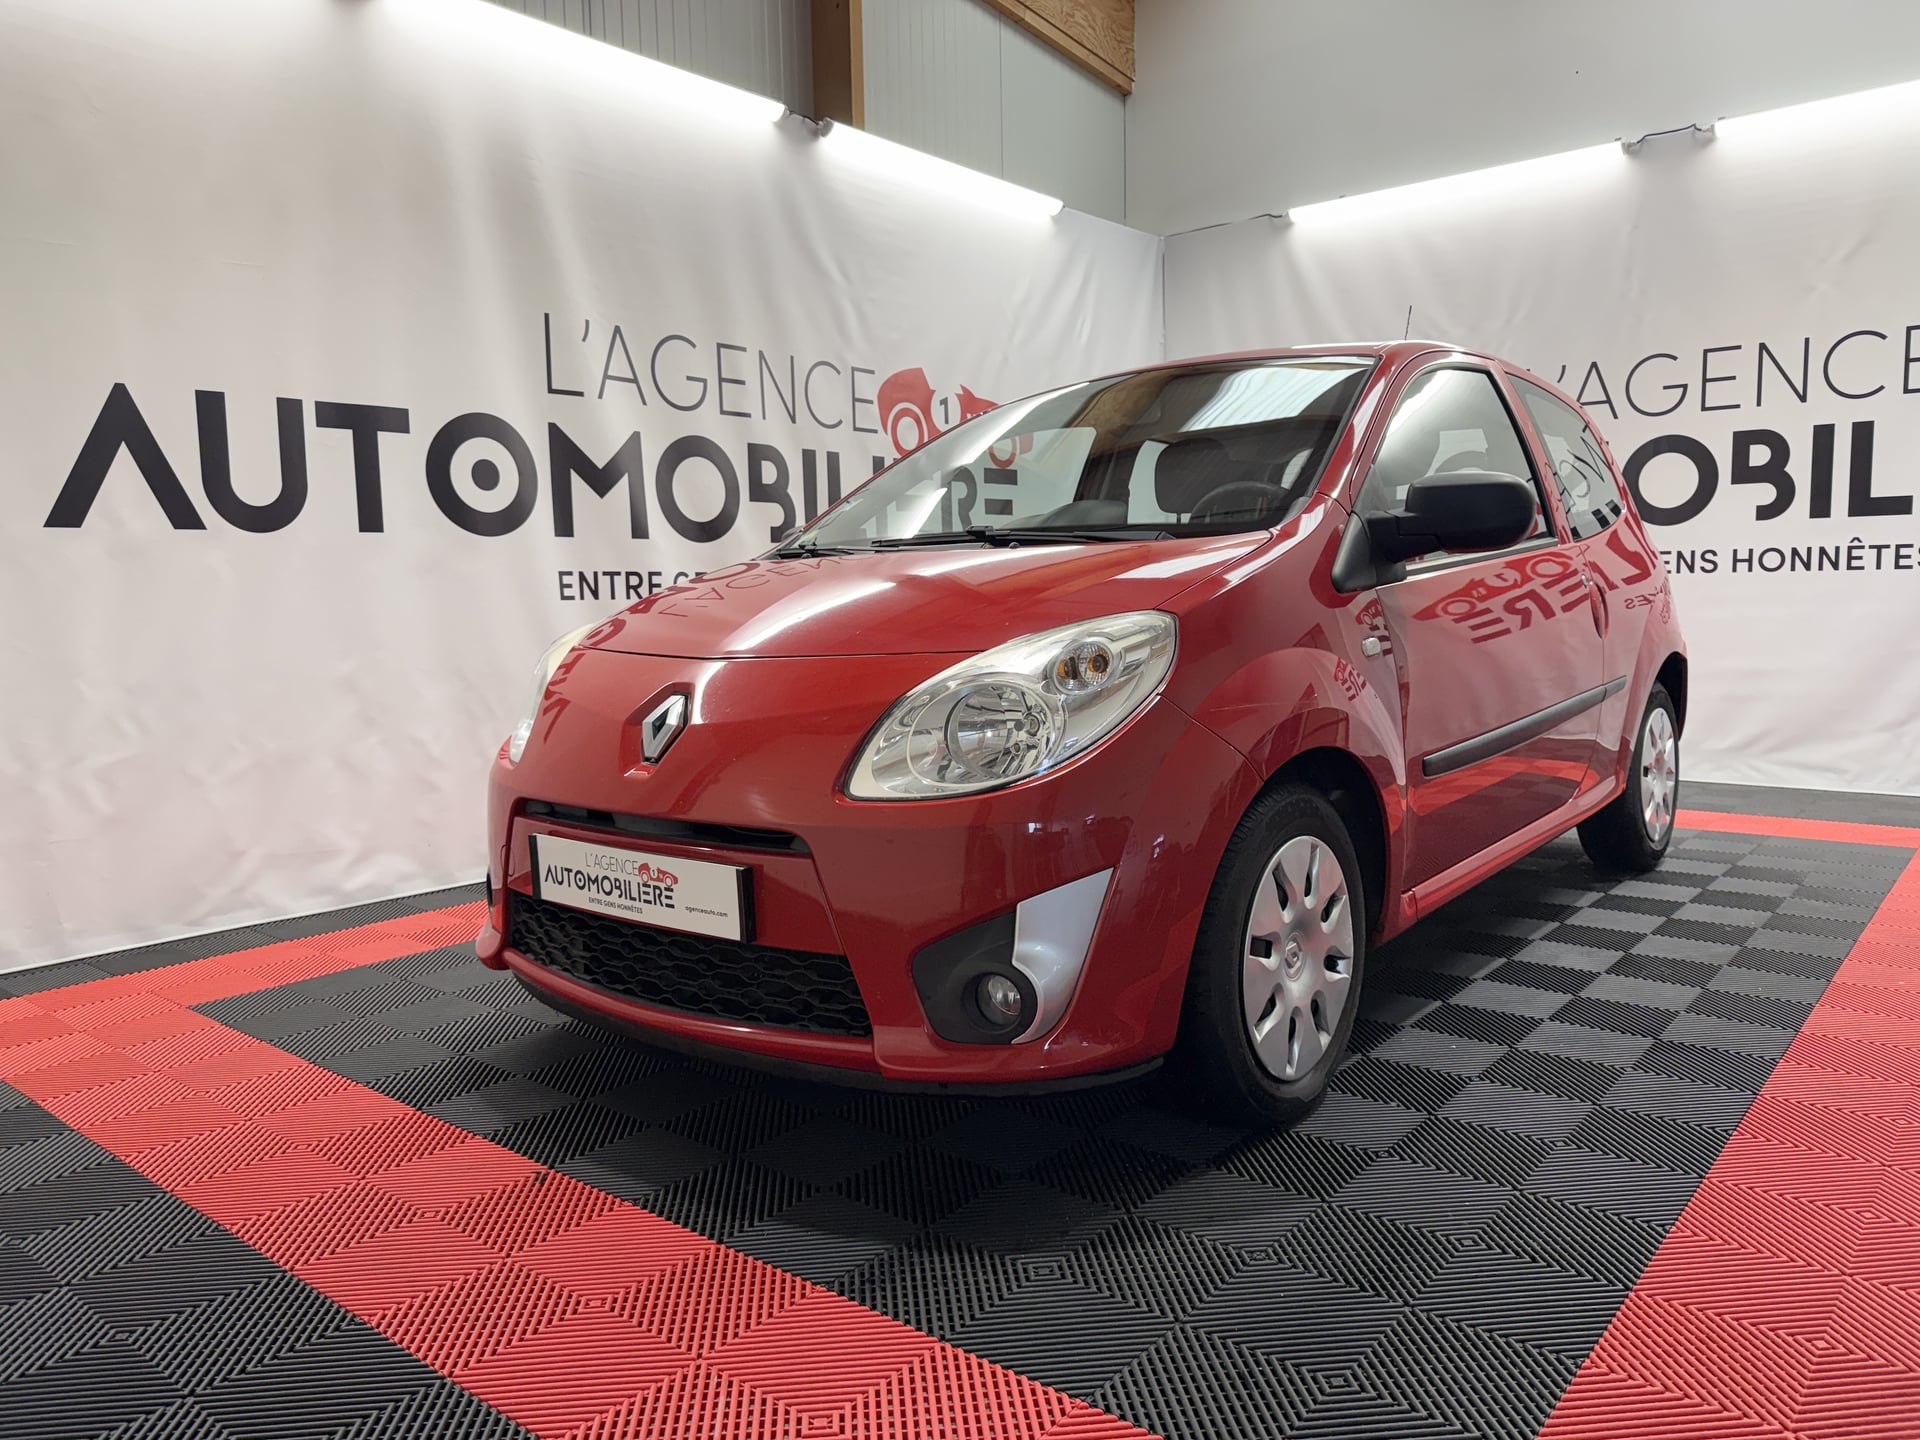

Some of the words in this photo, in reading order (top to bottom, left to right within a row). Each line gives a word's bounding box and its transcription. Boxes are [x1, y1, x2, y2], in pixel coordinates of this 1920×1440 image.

[544, 312, 879, 434] L'AGENCE
[1557, 325, 1920, 420] 'AGENCE
[939, 396, 949, 425] 1
[1732, 537, 1920, 573] HONNÊTE
[558, 571, 662, 600] ENTRE
[585, 851, 640, 877] L'AGENCE
[545, 863, 675, 909] AUTOMOBILIERE
[588, 897, 603, 906] ENTRE
[604, 900, 617, 909] GENS
[685, 906, 728, 917] agenceauto.com
